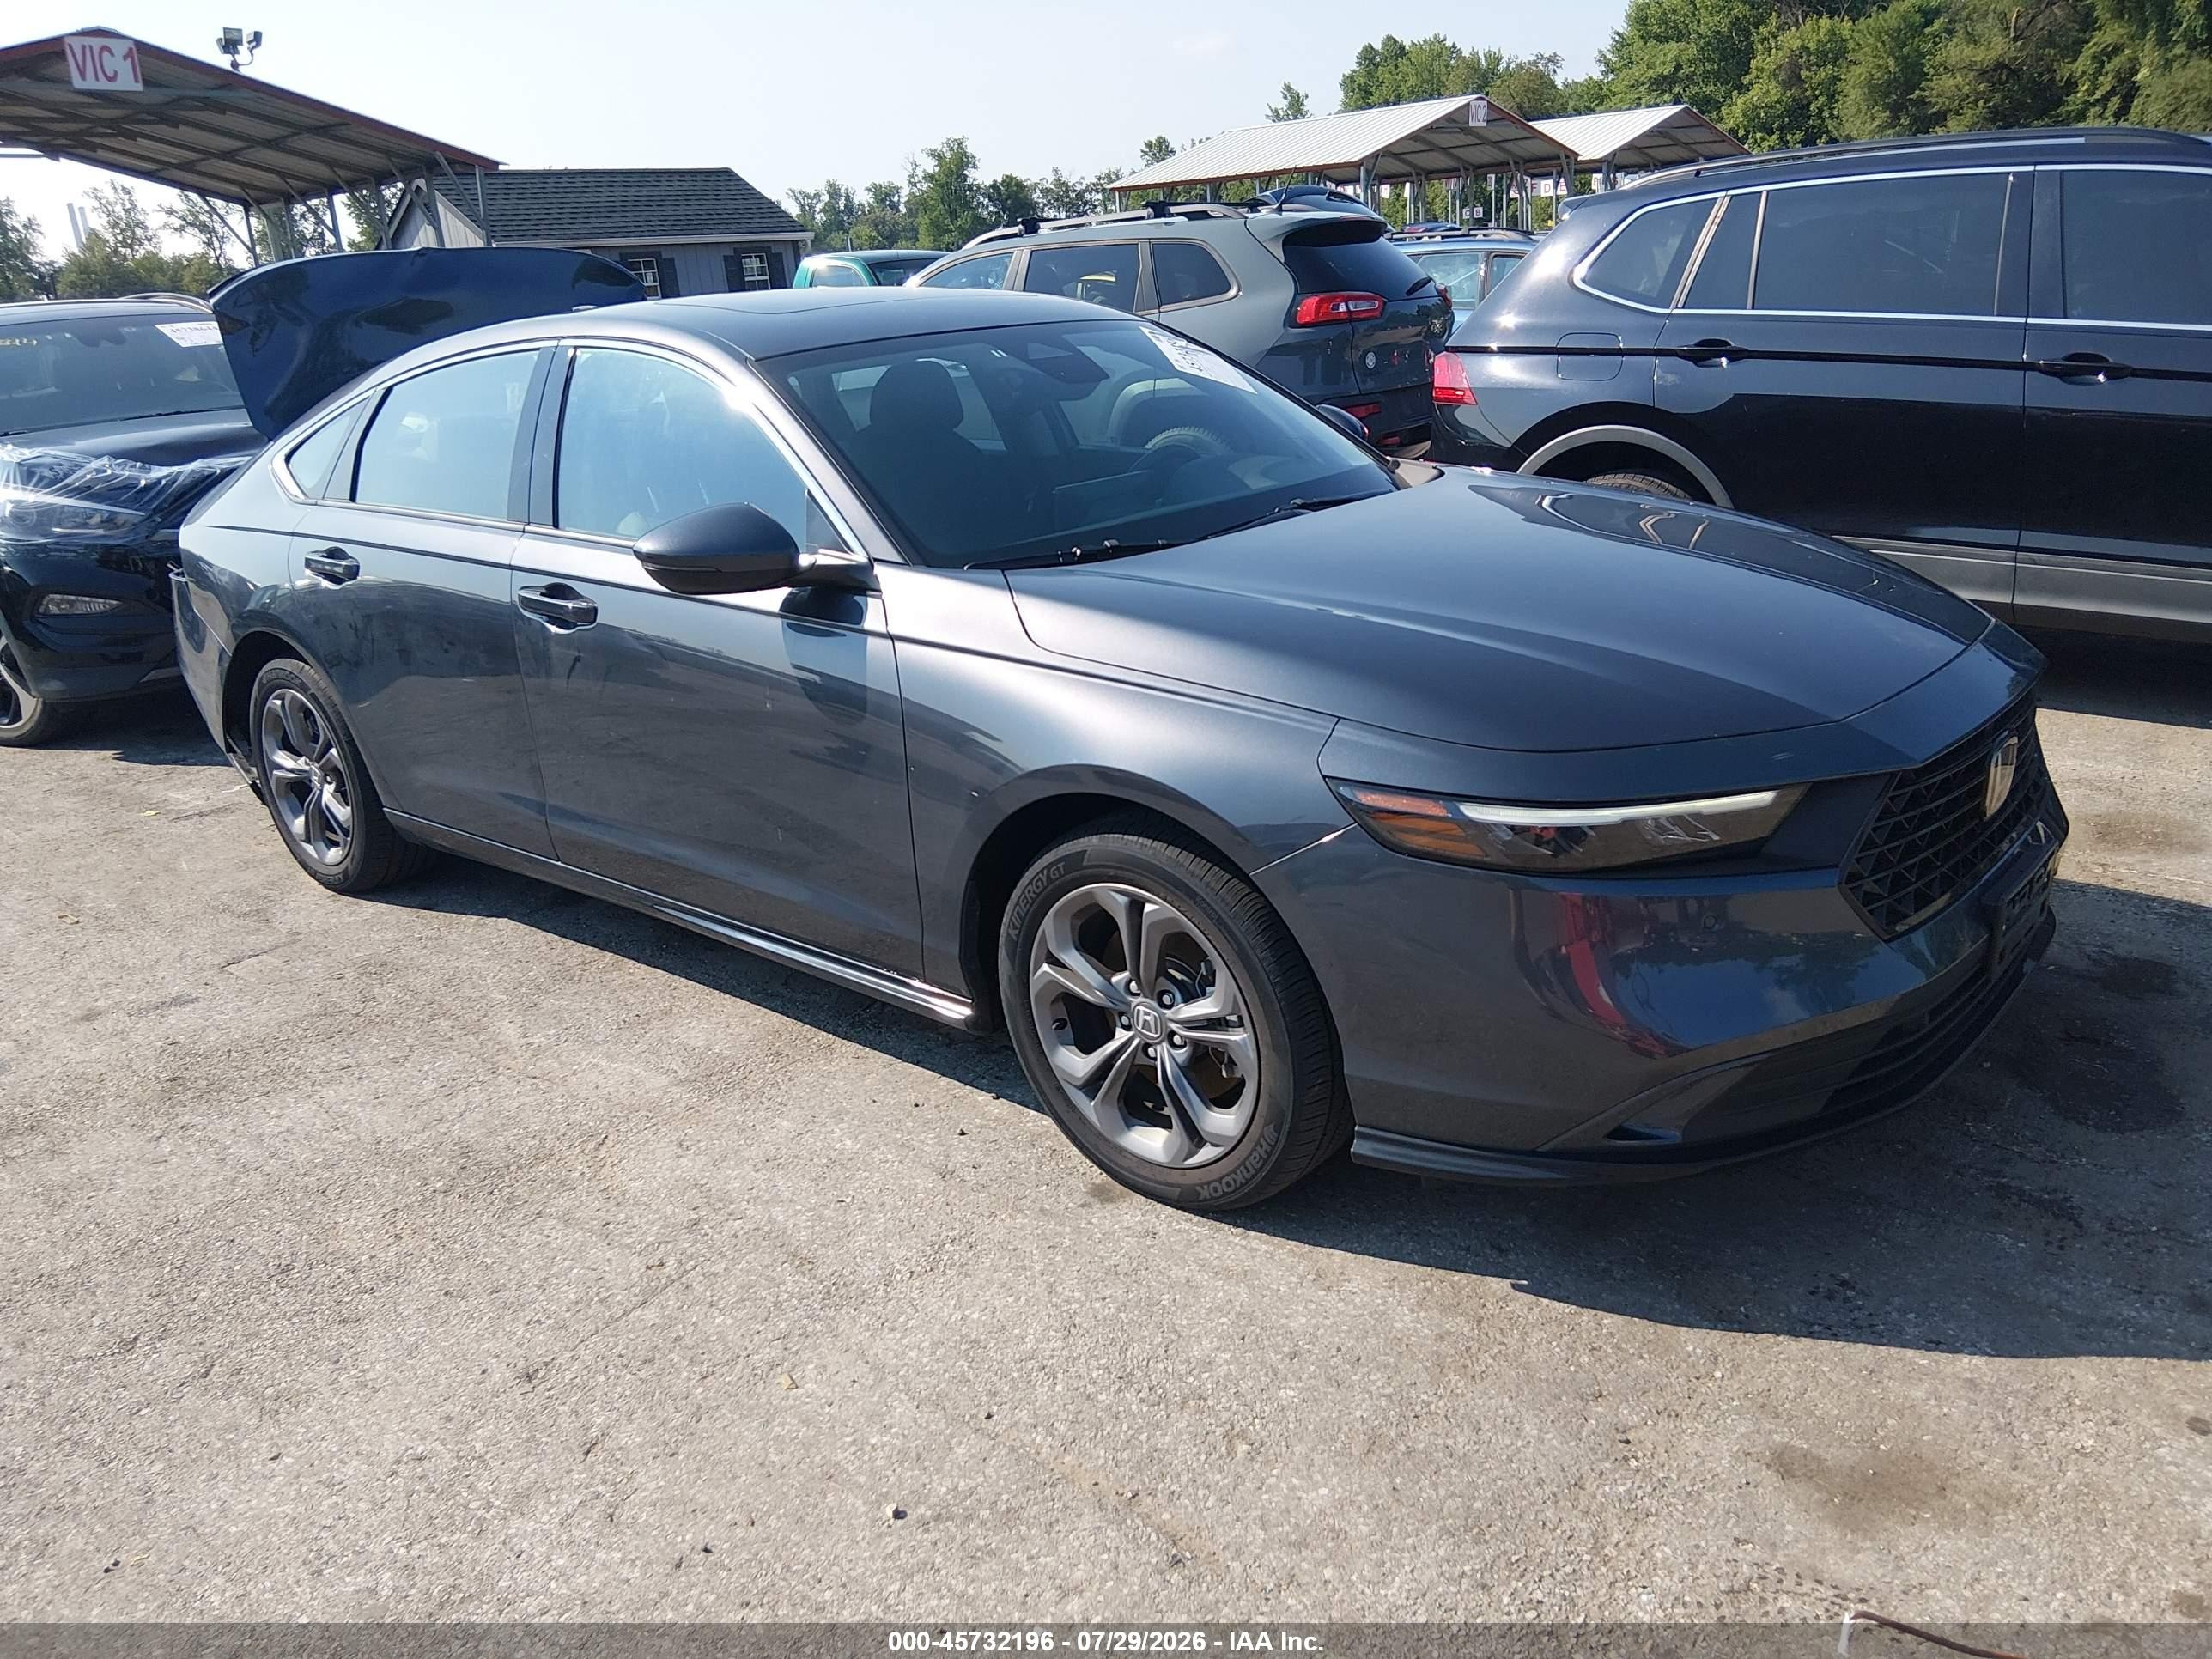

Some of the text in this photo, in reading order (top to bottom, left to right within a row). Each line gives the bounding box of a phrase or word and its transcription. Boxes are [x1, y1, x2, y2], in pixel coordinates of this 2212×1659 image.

[68, 42, 140, 83] VIC 1
[1470, 104, 1481, 123] VIC
[1544, 183, 1551, 193] D
[1050, 862, 1066, 879] GT
